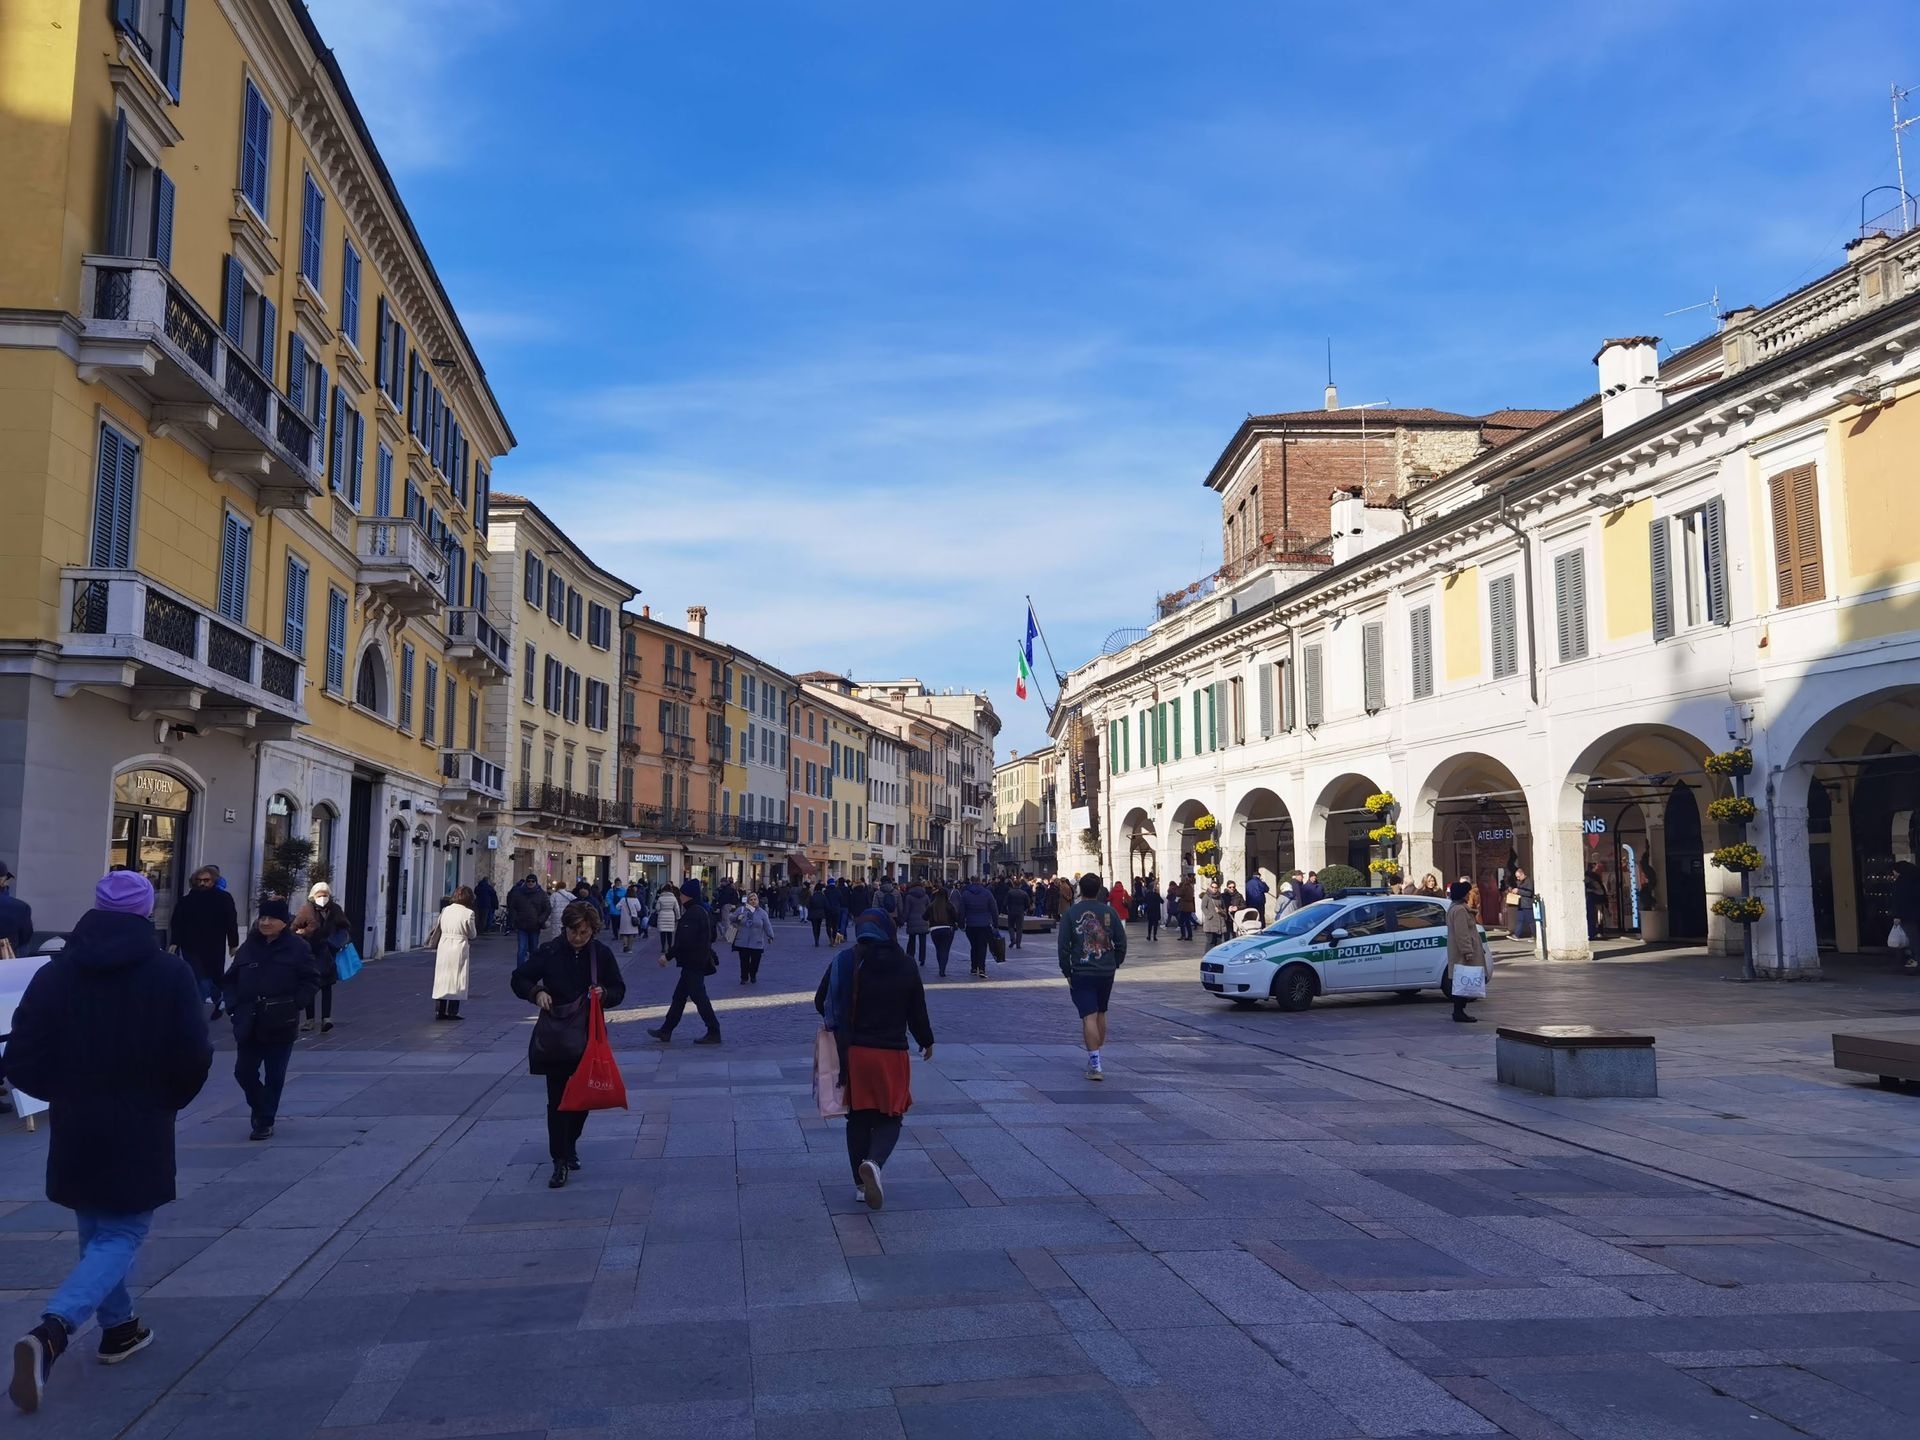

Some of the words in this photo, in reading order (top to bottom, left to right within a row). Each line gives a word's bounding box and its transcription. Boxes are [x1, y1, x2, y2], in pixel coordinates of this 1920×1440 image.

[137, 776, 152, 790] DAN
[153, 779, 173, 794] JOHN
[1478, 829, 1504, 840] ATELIER
[635, 854, 664, 862] CALZEDONIA
[1338, 944, 1380, 958] POLIZIA
[1398, 938, 1438, 951] LOCALE
[1460, 976, 1482, 988] OVS
